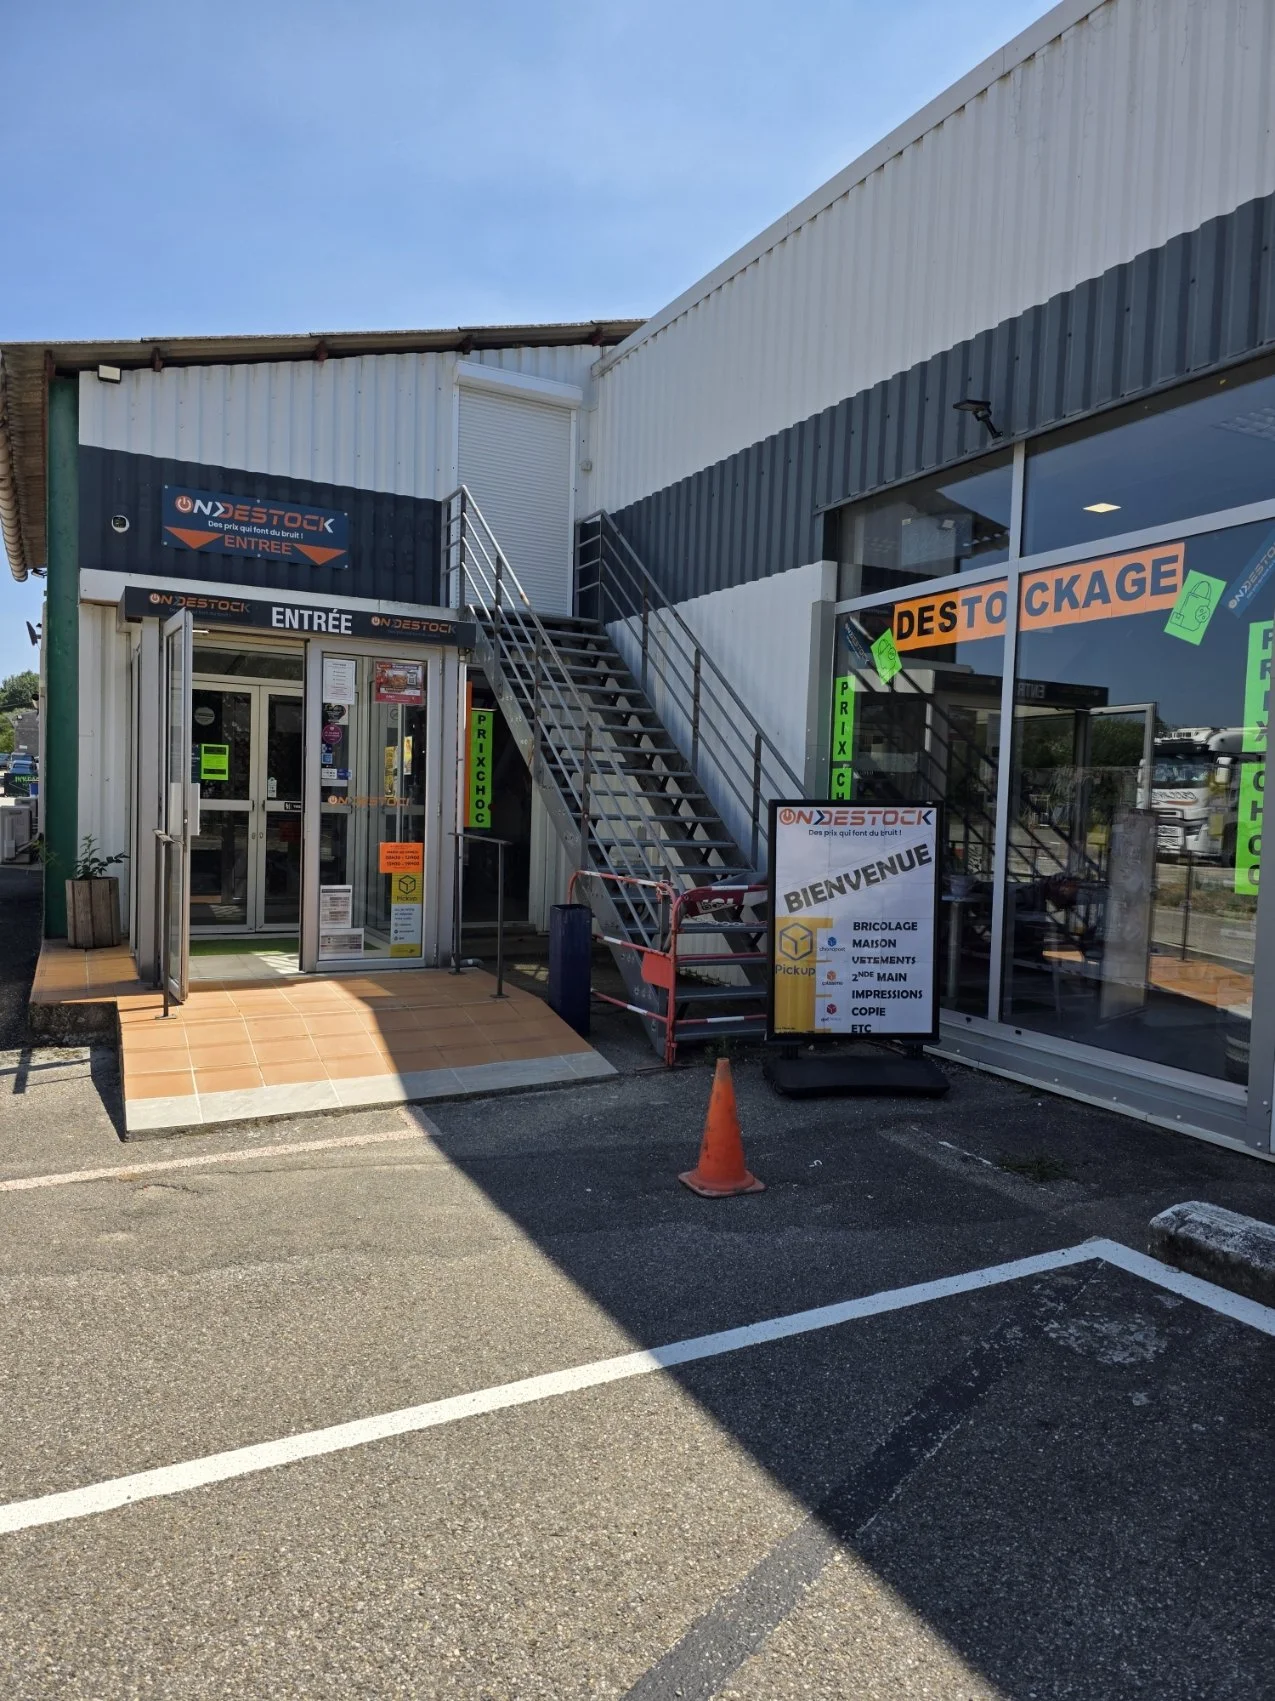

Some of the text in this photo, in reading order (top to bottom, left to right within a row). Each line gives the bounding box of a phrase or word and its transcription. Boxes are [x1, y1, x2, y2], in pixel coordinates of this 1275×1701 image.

[207, 520, 223, 529] Des
[224, 522, 239, 532] prix
[240, 523, 253, 534] qui
[253, 524, 270, 535] font
[270, 527, 280, 537] du
[281, 528, 300, 539] bruit
[224, 534, 294, 556] ENTREE
[896, 554, 1179, 640] DESTOCKAGE
[271, 606, 353, 635] ENTRÉE
[837, 680, 849, 756] PRIX
[824, 829, 838, 838] prix
[838, 829, 852, 838] qui
[852, 829, 868, 837] font
[783, 843, 933, 914] BIENVENUE
[852, 922, 918, 932] BRICOLAGE
[852, 938, 897, 948] MAISON
[852, 956, 916, 965] VETEMENTS
[776, 964, 816, 976] Pickup
[876, 972, 907, 982] MAIN
[852, 990, 923, 1000] IMPRESSIONS
[852, 1006, 886, 1016] COPIE
[851, 1024, 872, 1033] ETC
